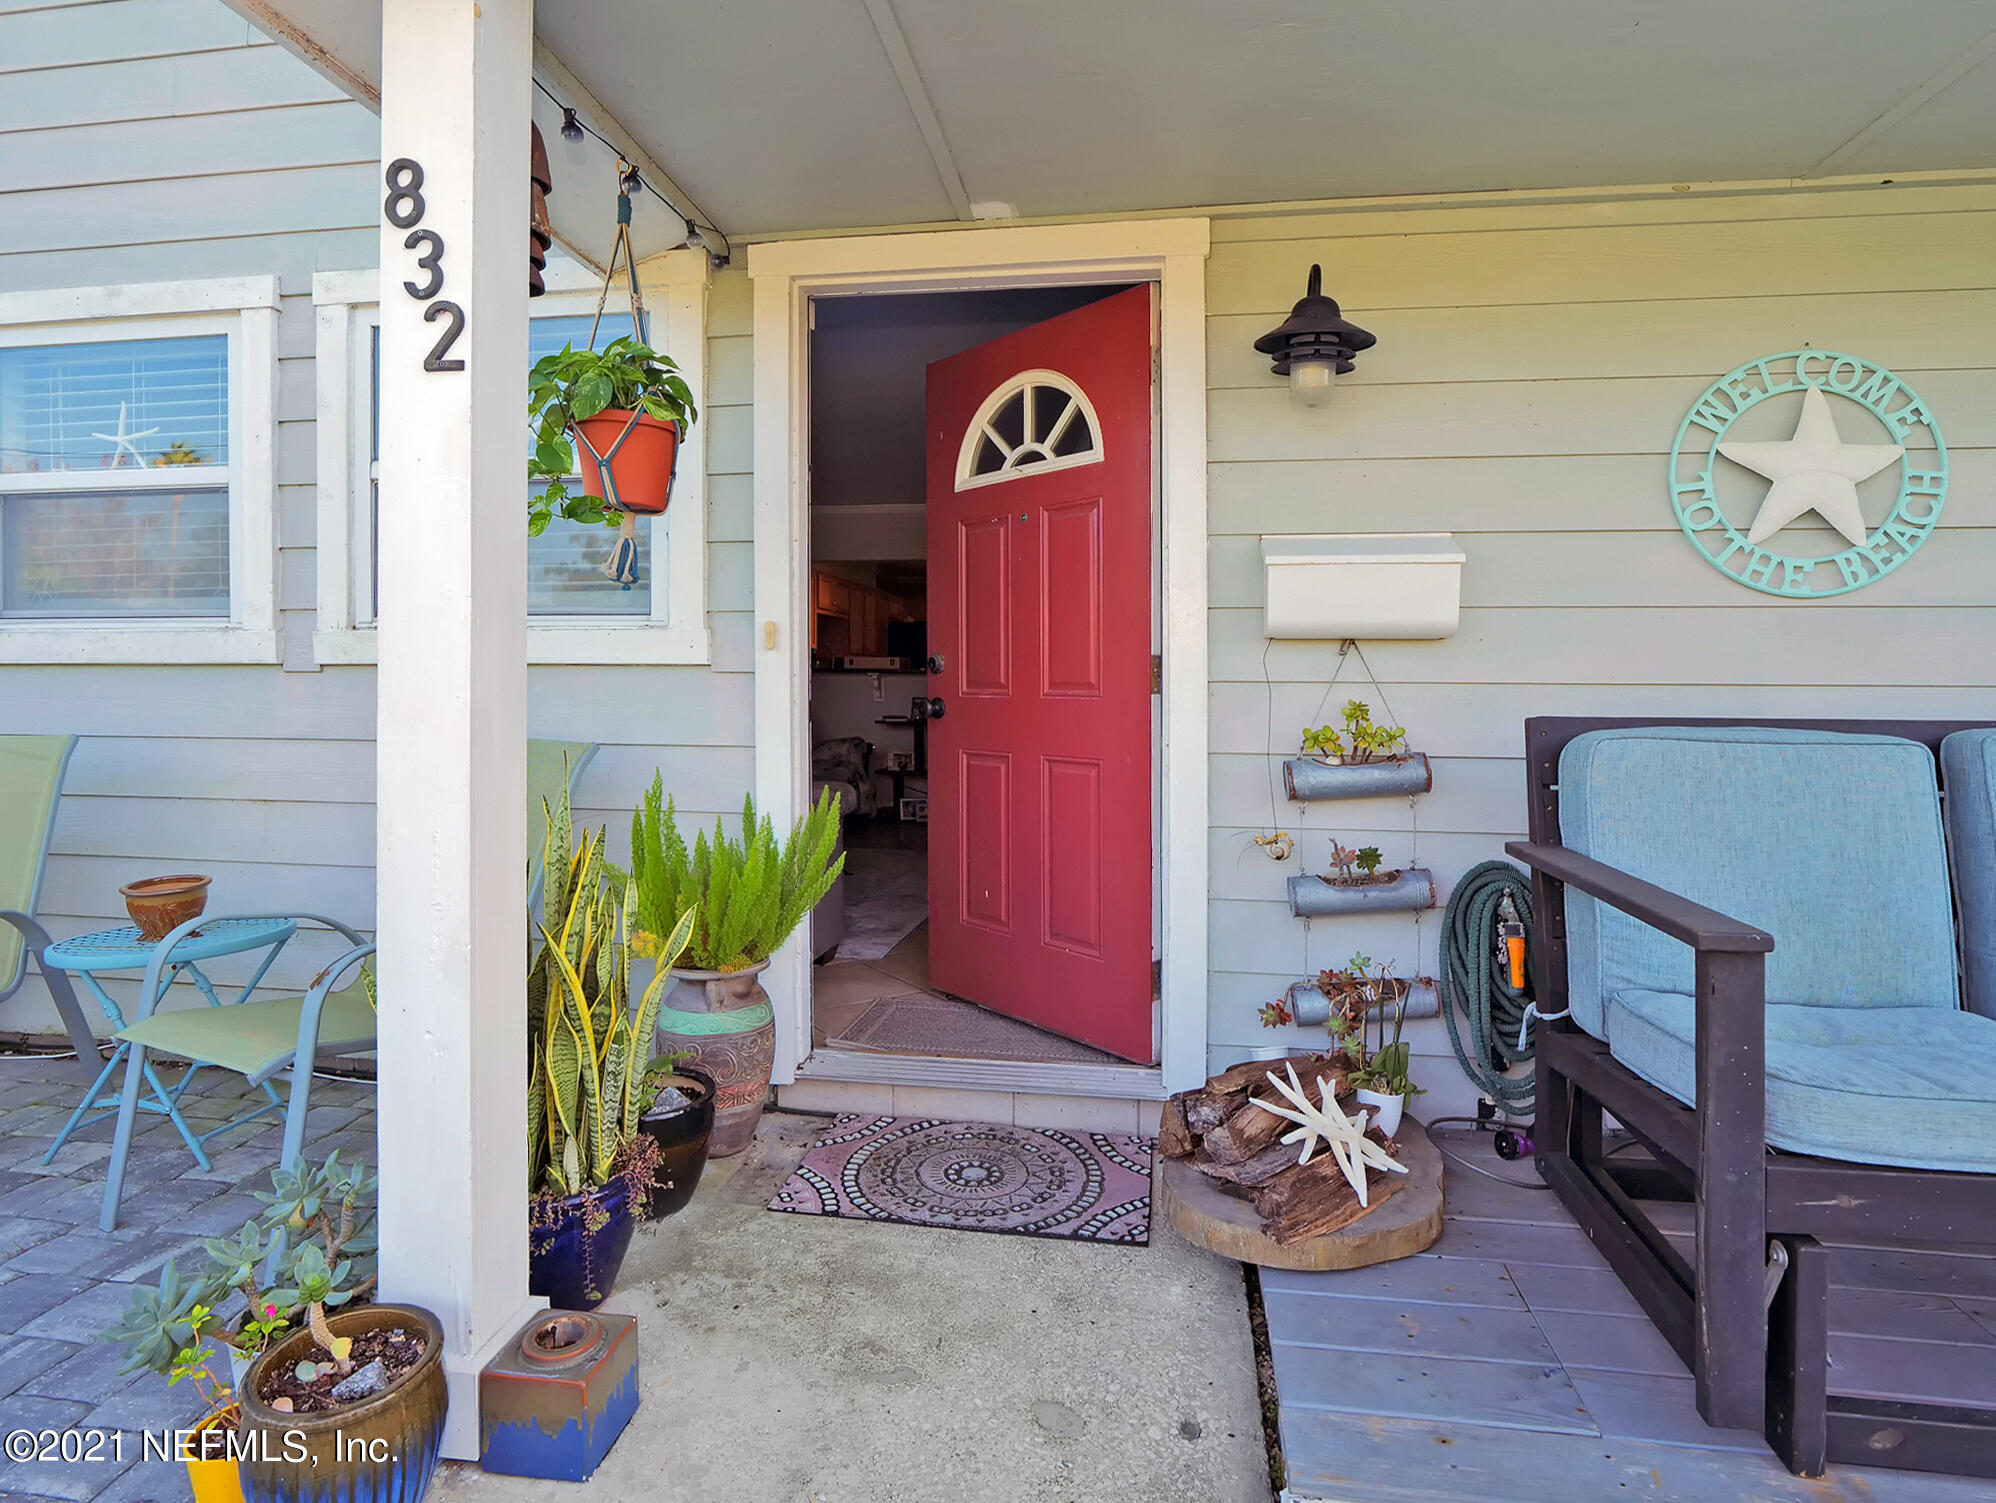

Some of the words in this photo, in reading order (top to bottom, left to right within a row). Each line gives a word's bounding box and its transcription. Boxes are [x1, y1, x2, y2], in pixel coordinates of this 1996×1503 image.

[384, 157, 465, 372] 832
[1689, 353, 1931, 439] WELCOME
[1674, 471, 1720, 531] TO
[1714, 530, 1815, 593] THE
[1833, 470, 1945, 587] BEACH
